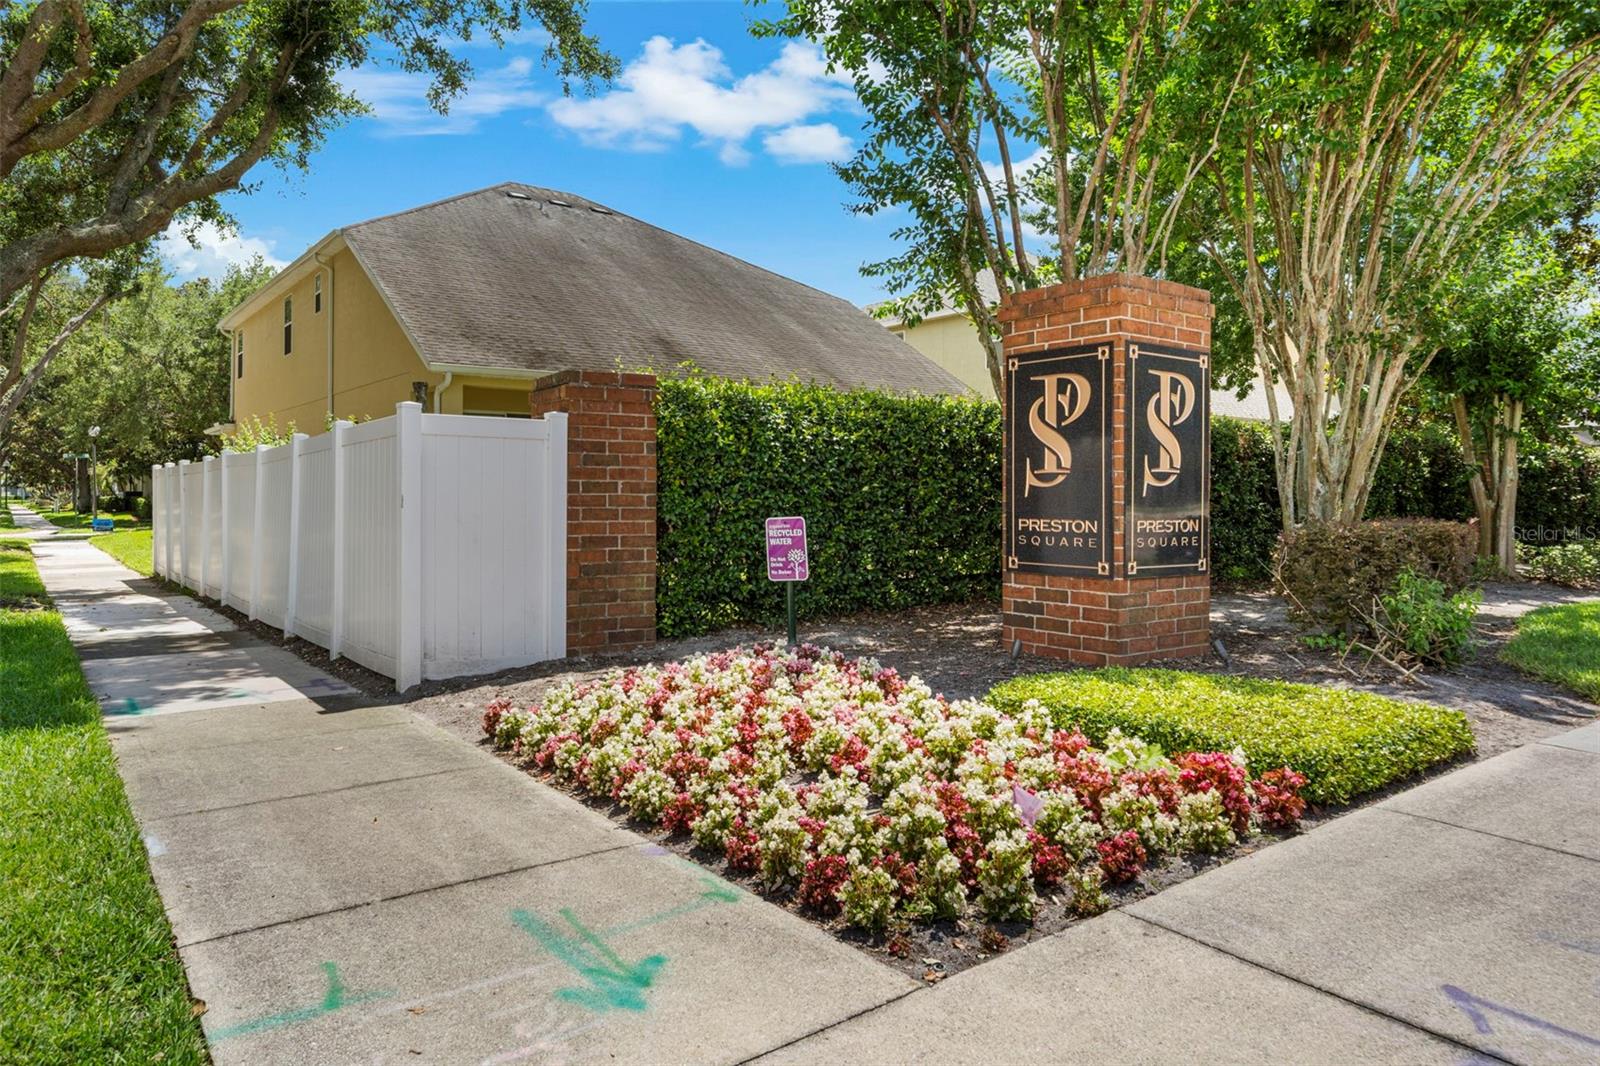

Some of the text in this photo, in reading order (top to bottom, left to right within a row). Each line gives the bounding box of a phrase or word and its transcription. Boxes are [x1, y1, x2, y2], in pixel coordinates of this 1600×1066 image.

[768, 529, 803, 537] RECYCLED
[1018, 518, 1098, 534] PRESTON
[1136, 519, 1199, 534] PRESTON
[1018, 535, 1098, 549] SQUARE
[1136, 536, 1199, 548] SQUARE
